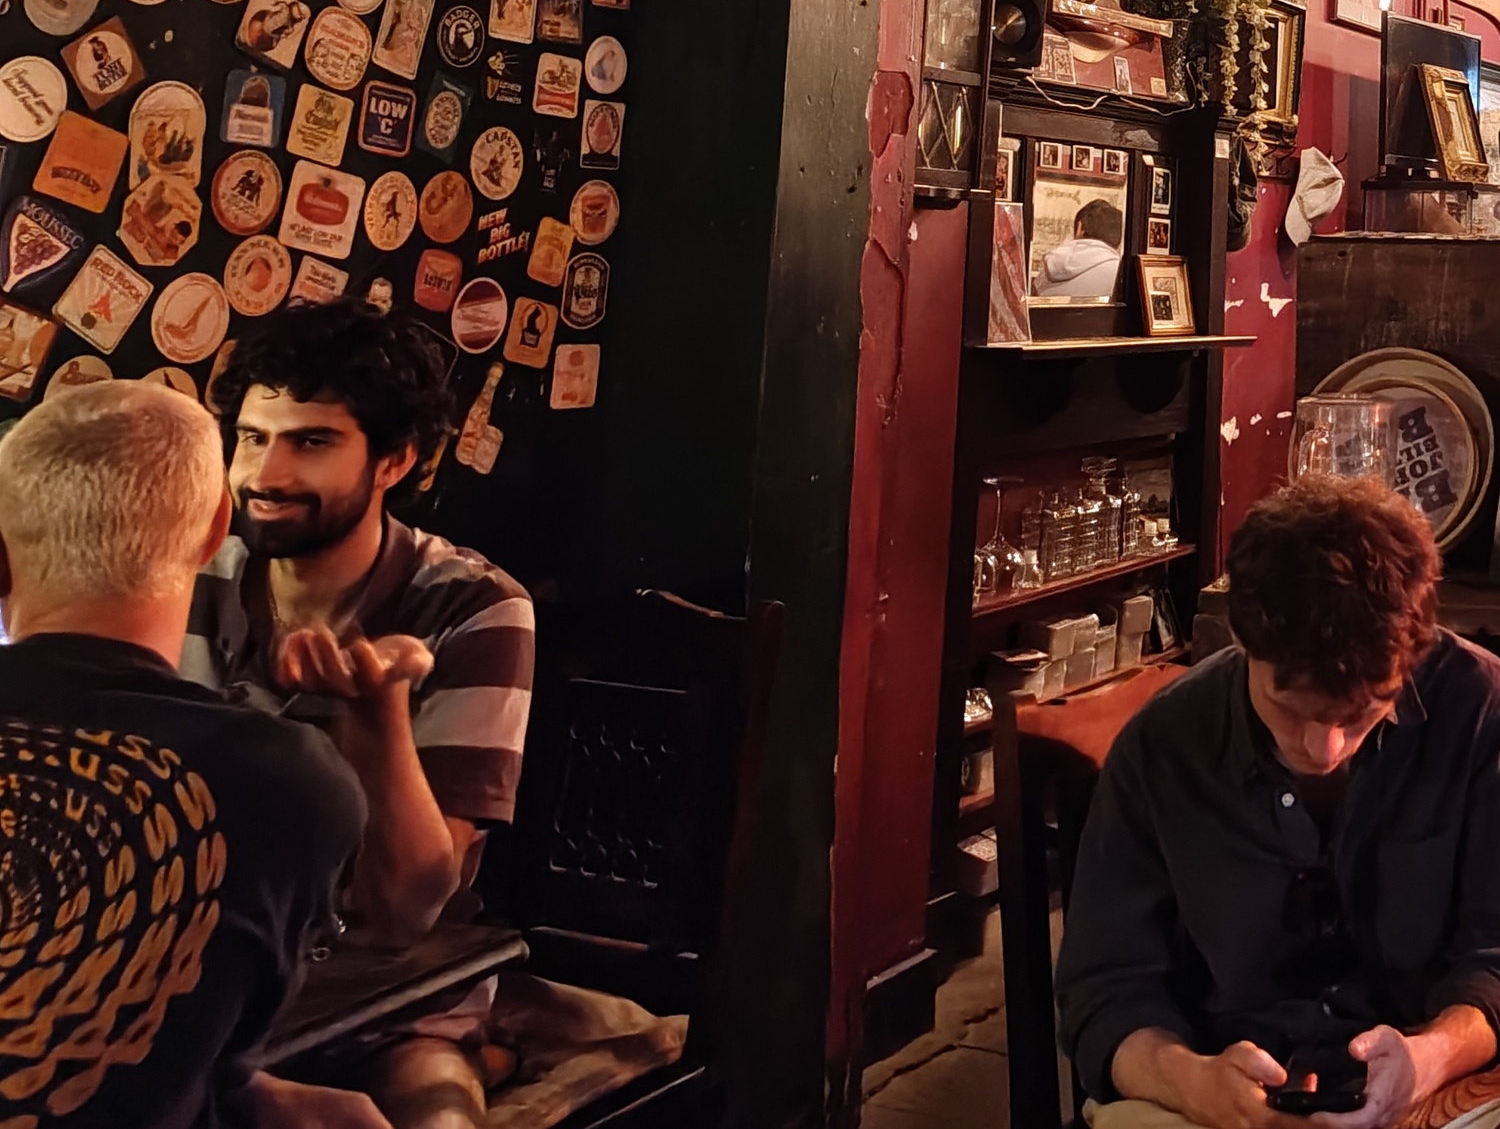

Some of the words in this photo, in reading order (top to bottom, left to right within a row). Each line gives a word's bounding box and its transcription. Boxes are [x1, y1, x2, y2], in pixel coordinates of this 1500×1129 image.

[444, 9, 481, 30] BADGER
[369, 94, 408, 119] LOW
[484, 129, 521, 170] CAPSTAN
[21, 197, 84, 251] MOUSSEC
[476, 208, 509, 232] NEW
[490, 221, 514, 244] BIG
[90, 257, 115, 277] RED
[113, 270, 144, 303] ROCK
